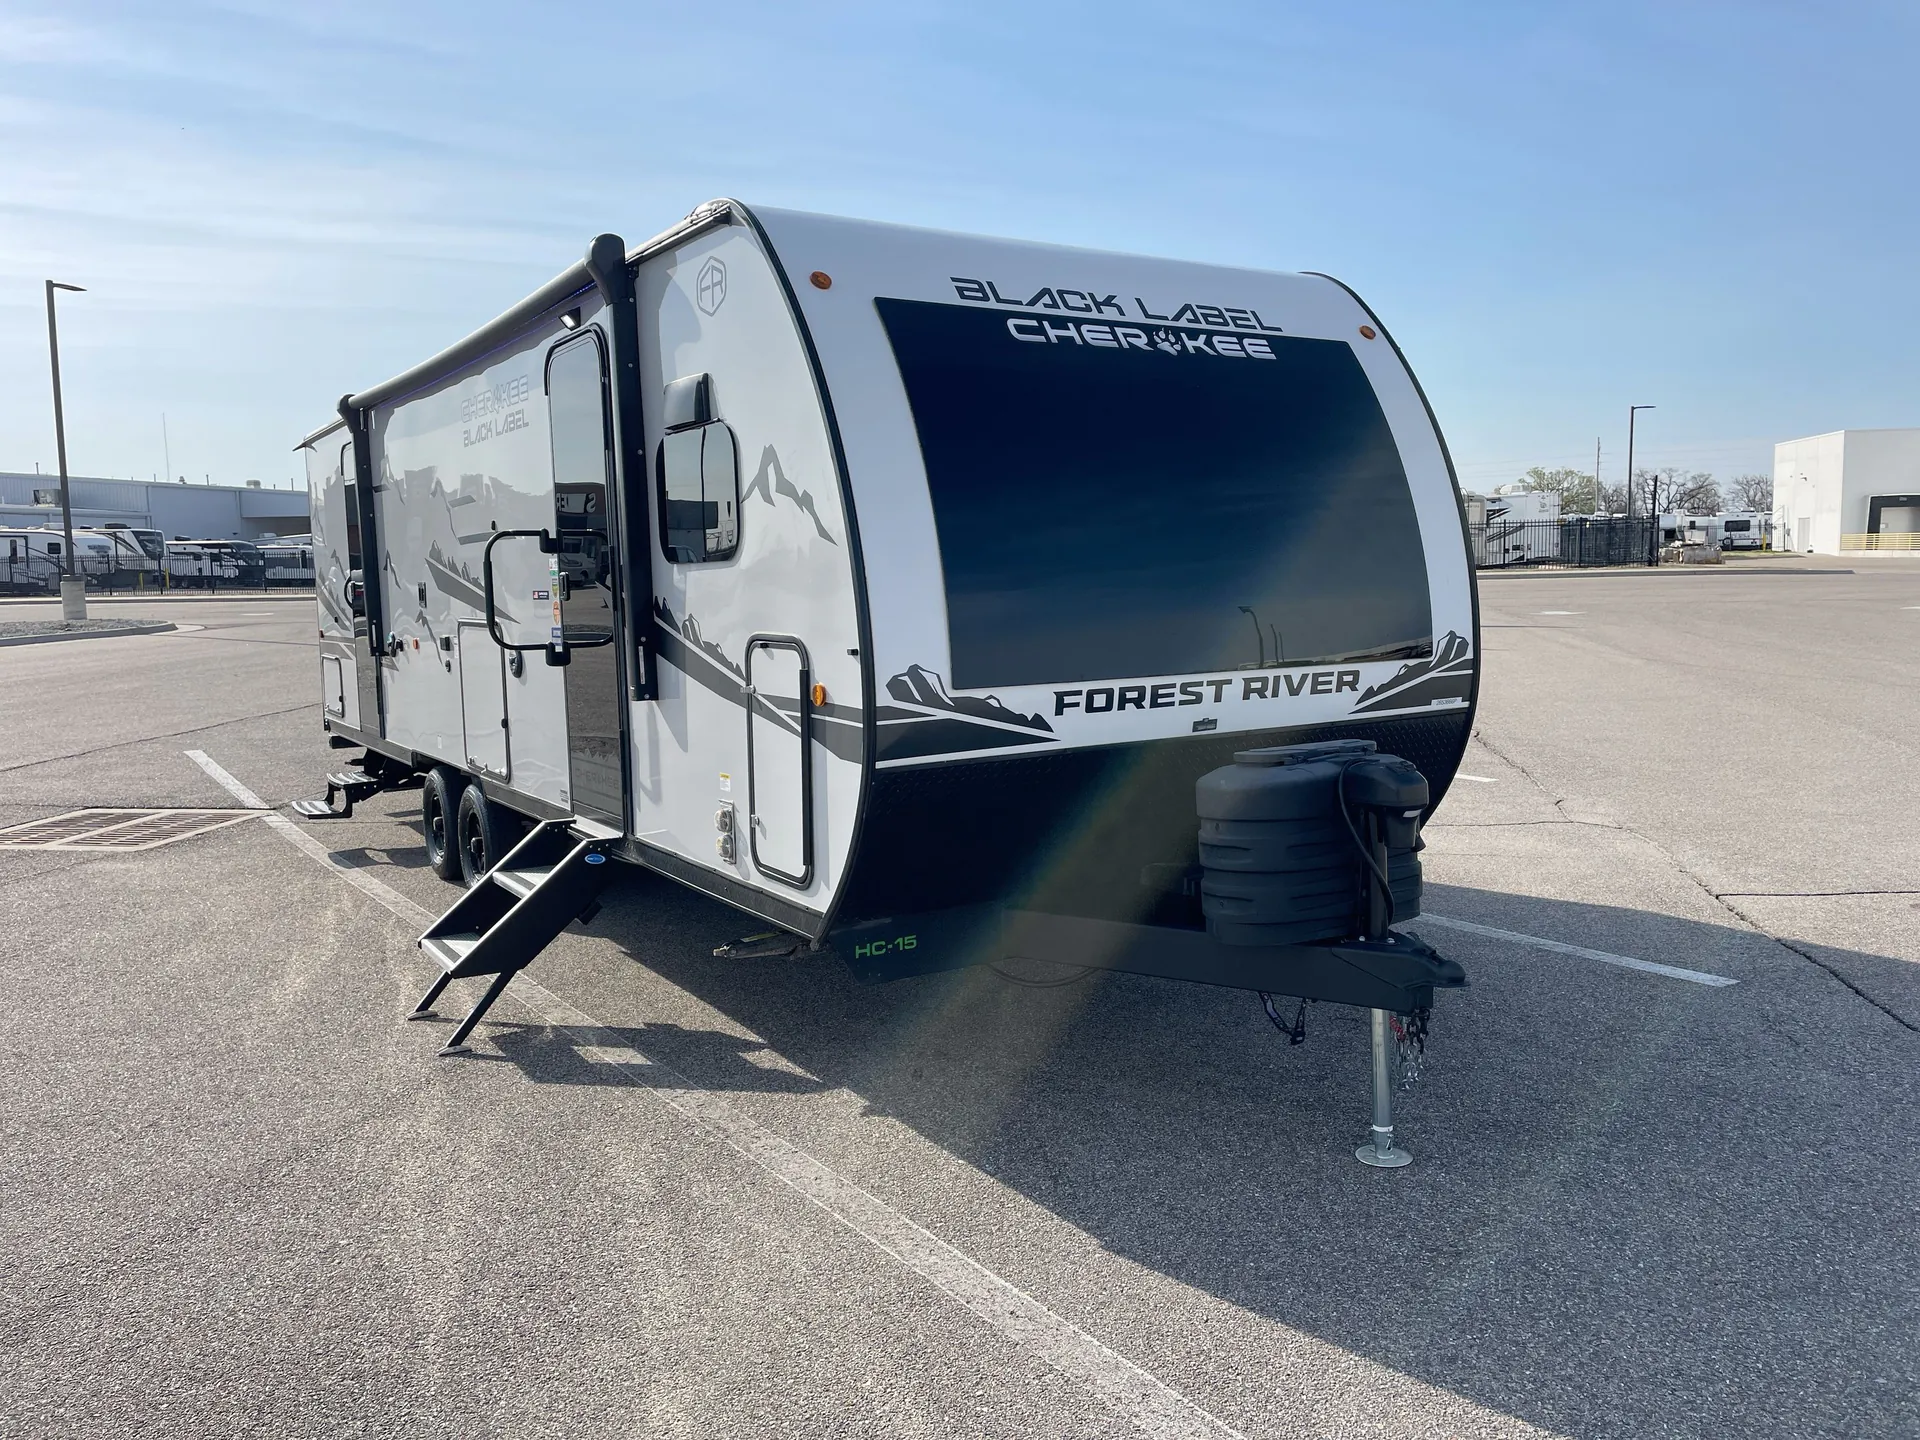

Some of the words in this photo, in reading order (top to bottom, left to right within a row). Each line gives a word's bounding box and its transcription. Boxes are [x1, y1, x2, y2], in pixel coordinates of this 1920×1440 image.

[950, 276, 1126, 316] BLACK
[1135, 297, 1284, 333] LABEL
[463, 420, 493, 448] BLACK
[495, 408, 529, 437] LABEL
[1053, 678, 1233, 716] FOREST
[1242, 669, 1360, 701] RIVER
[855, 934, 918, 959] HC-15
